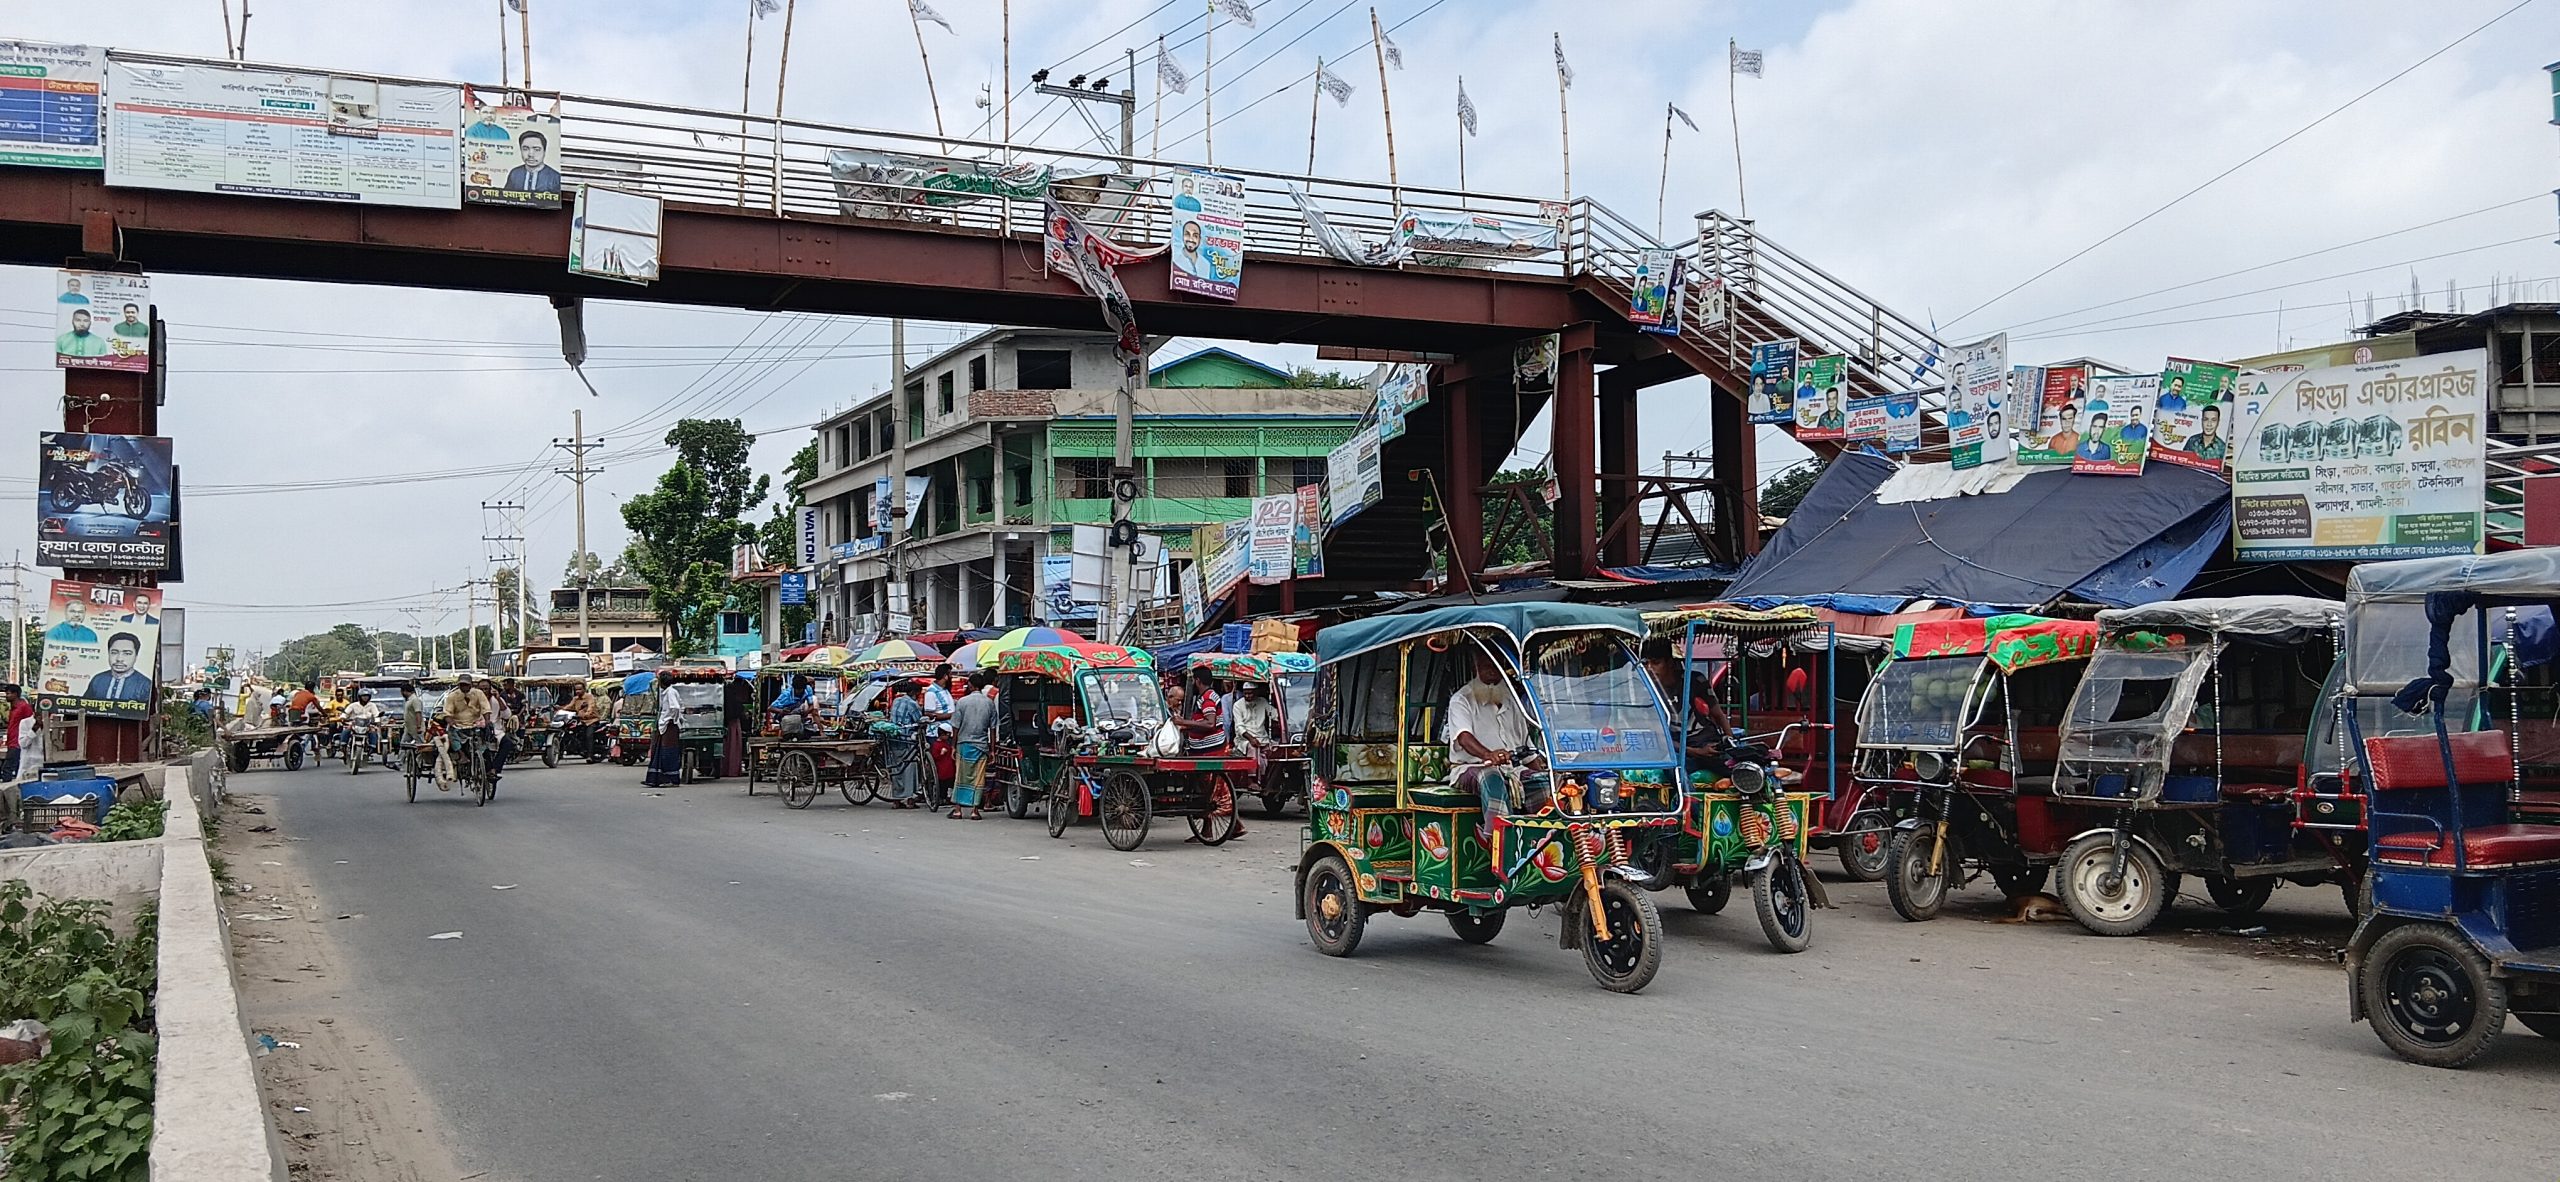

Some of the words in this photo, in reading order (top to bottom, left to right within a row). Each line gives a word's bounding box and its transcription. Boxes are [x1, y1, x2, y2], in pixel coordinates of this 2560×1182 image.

[221, 83, 245, 91] কারিগরি
[534, 190, 559, 201] কবির
[1206, 236, 1242, 253] শুভেচ্ছা
[1174, 276, 1190, 287] মোঃ
[1969, 379, 2002, 396] শুভেচ্ছা
[2238, 381, 2269, 397] S.A
[2296, 380, 2349, 415] সিংড়া
[2357, 365, 2477, 406] এন্টারপ্রাইজ
[2246, 401, 2260, 416] R
[2408, 404, 2475, 452] রবিন
[2315, 465, 2340, 479] সিংড়া,
[2375, 462, 2408, 475] বনপাড়া,
[2315, 481, 2348, 495] নবীনগর,
[2351, 482, 2378, 494] সাভার,
[2418, 474, 2464, 490] টেকনিক্যাল
[2315, 500, 2353, 512] কল্যাণপুর,
[804, 510, 815, 564] WALTON
[39, 540, 80, 554] কৃষাণ
[82, 541, 117, 553] হোন্ডা
[119, 541, 166, 555] সেন্টার
[117, 699, 147, 711] কবির
[1559, 731, 1598, 753] 金品
[1624, 730, 1658, 752] 集团
